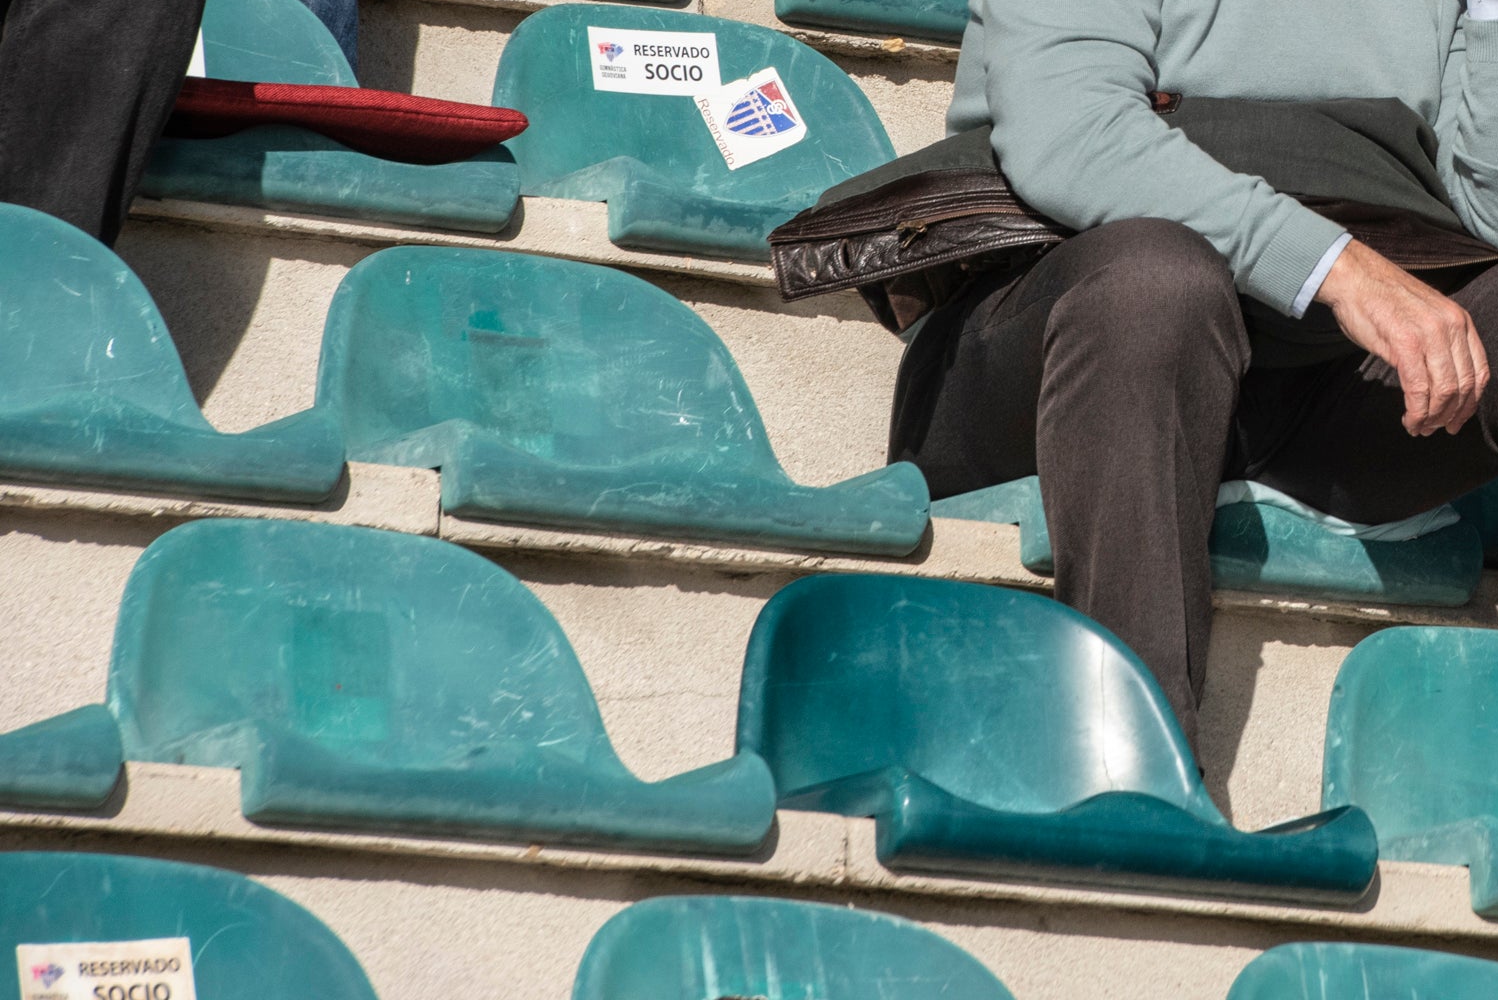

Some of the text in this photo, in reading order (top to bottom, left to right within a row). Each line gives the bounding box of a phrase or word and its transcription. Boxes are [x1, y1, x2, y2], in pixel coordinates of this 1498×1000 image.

[633, 44, 710, 59] RESERVADO
[644, 63, 703, 81] SOCIO
[698, 98, 735, 165] Reservado
[79, 958, 182, 977] RESERVADO
[93, 982, 171, 1000] SOCIO
